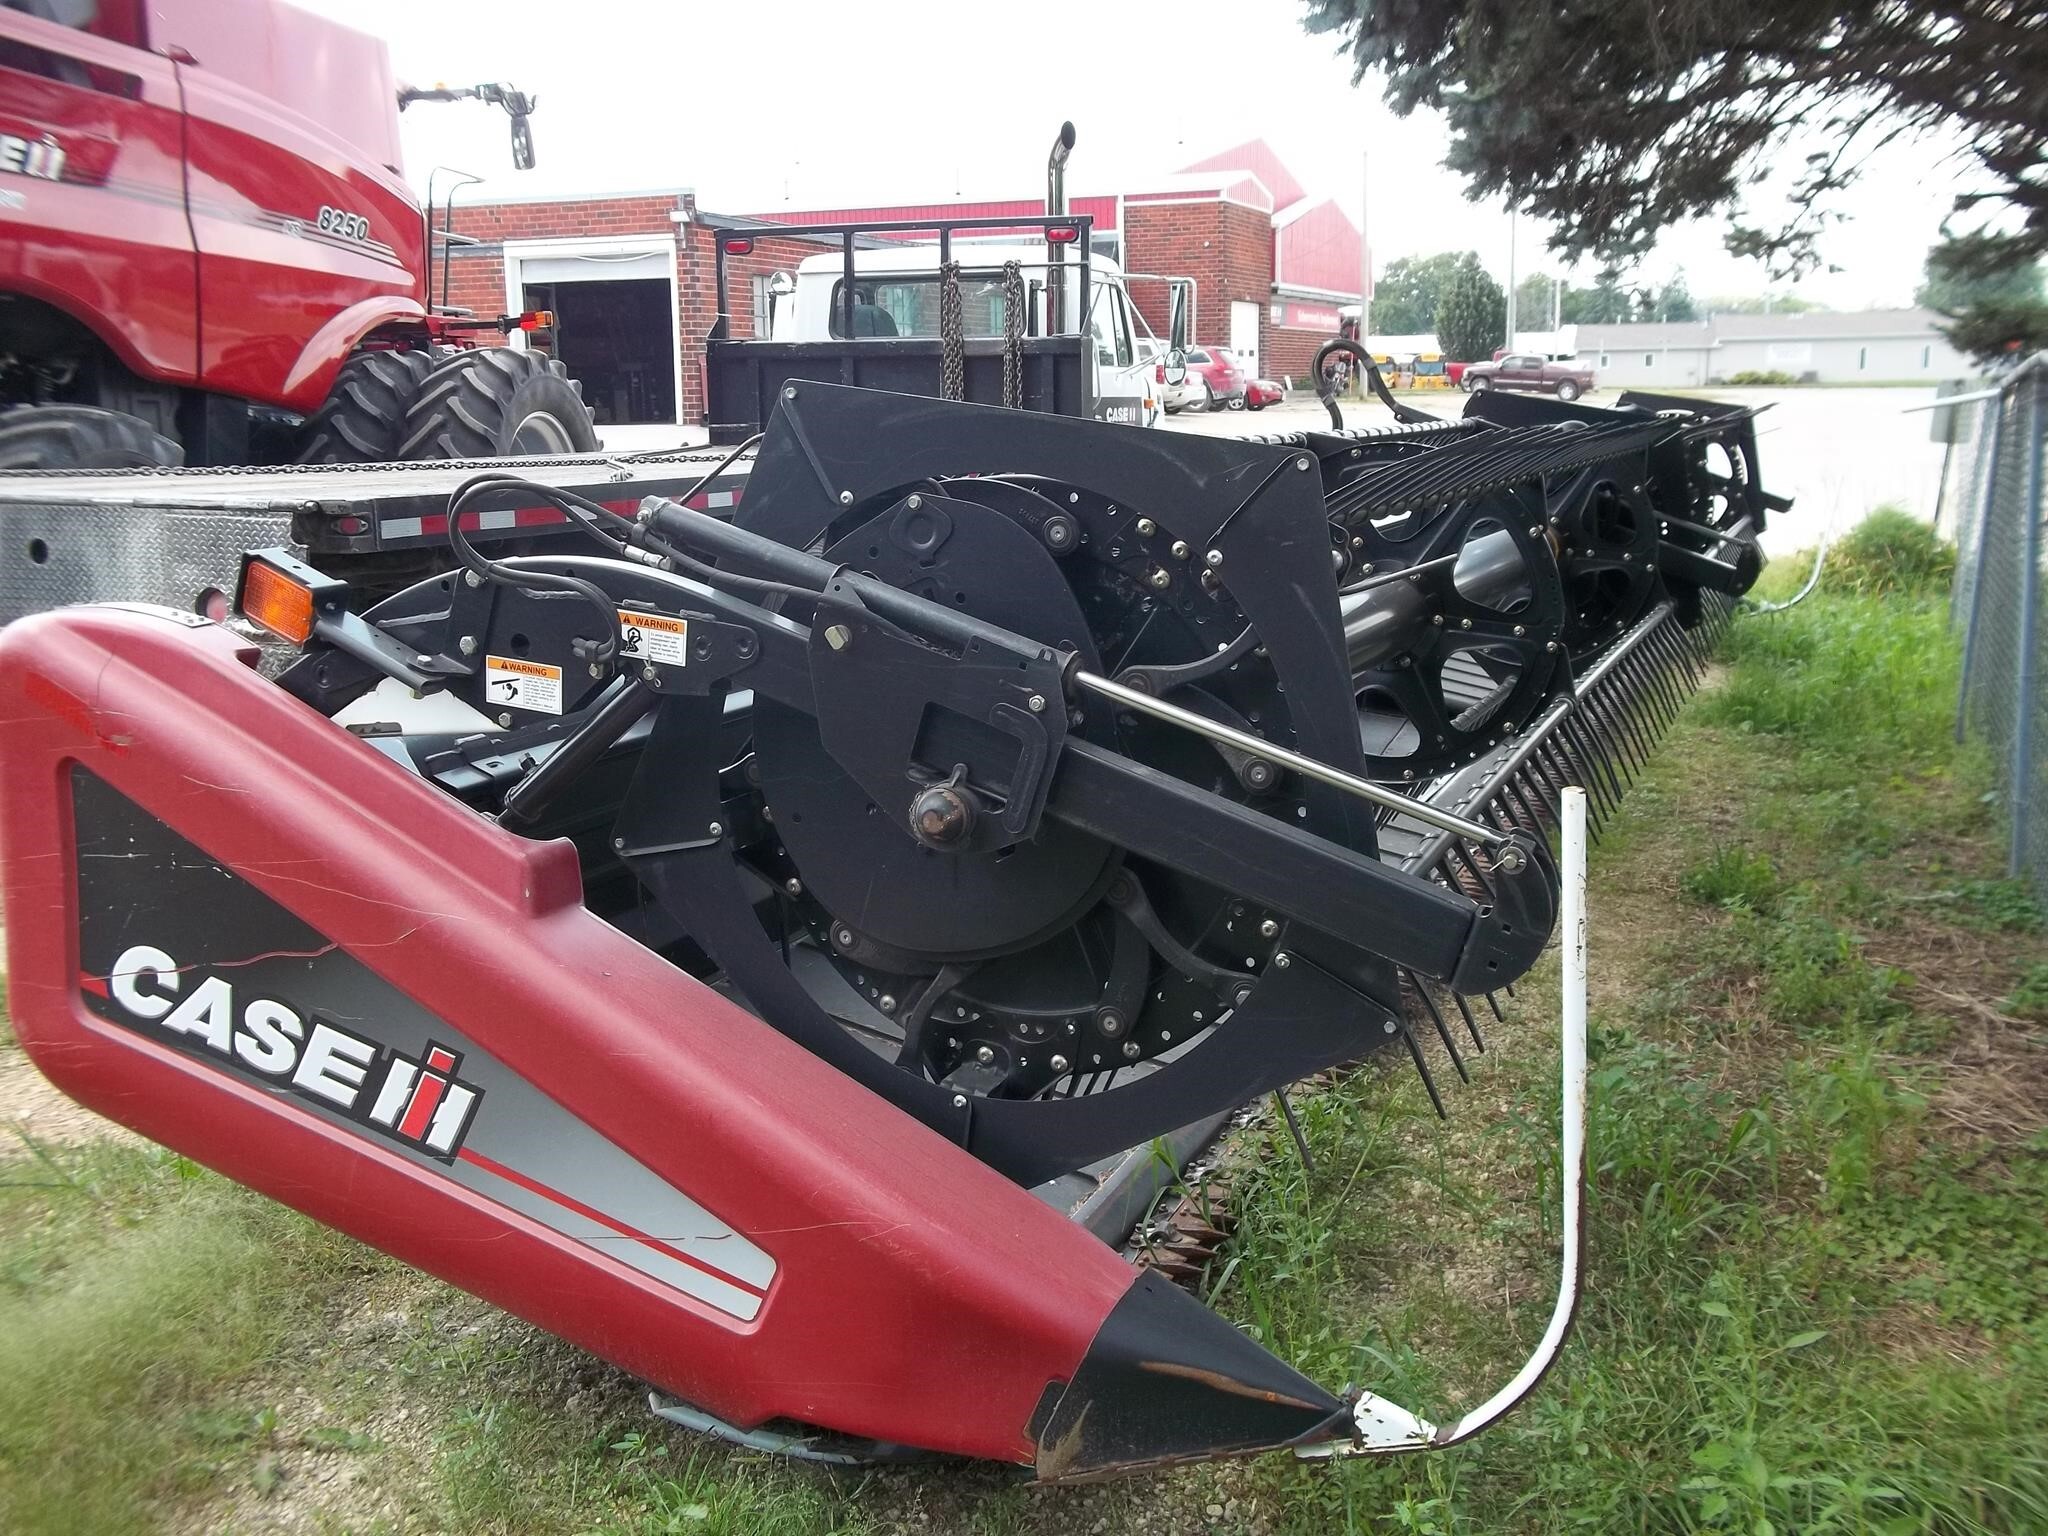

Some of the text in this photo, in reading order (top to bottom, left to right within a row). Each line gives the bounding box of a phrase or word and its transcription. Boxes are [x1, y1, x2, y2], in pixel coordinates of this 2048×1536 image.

[318, 205, 369, 241] 8250
[1106, 407, 1128, 423] CASE
[635, 617, 679, 632] WARNING
[509, 662, 547, 676] WARNING
[110, 945, 378, 1108] CASE
